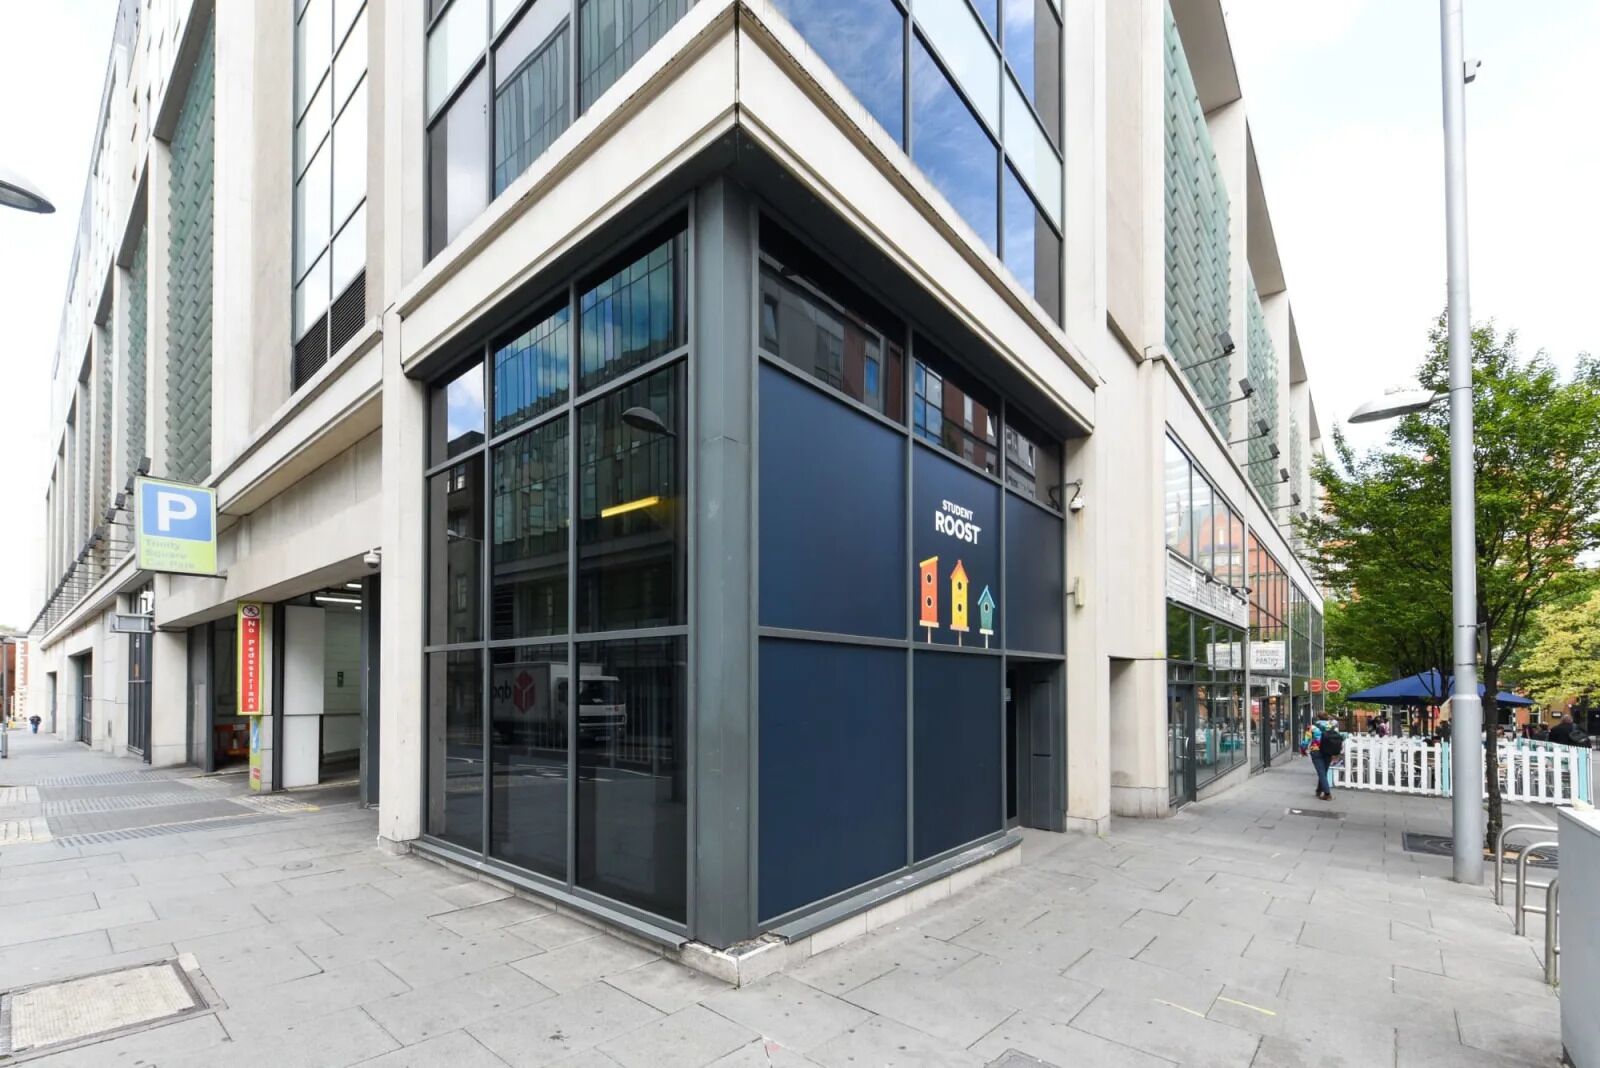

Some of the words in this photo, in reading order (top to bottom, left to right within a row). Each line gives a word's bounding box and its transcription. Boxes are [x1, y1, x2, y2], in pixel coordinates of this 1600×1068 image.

[158, 491, 197, 531] P
[942, 499, 974, 520] STUDENT
[935, 510, 982, 544] ROOST
[247, 620, 255, 633] No
[247, 639, 255, 710] Pedestrians
